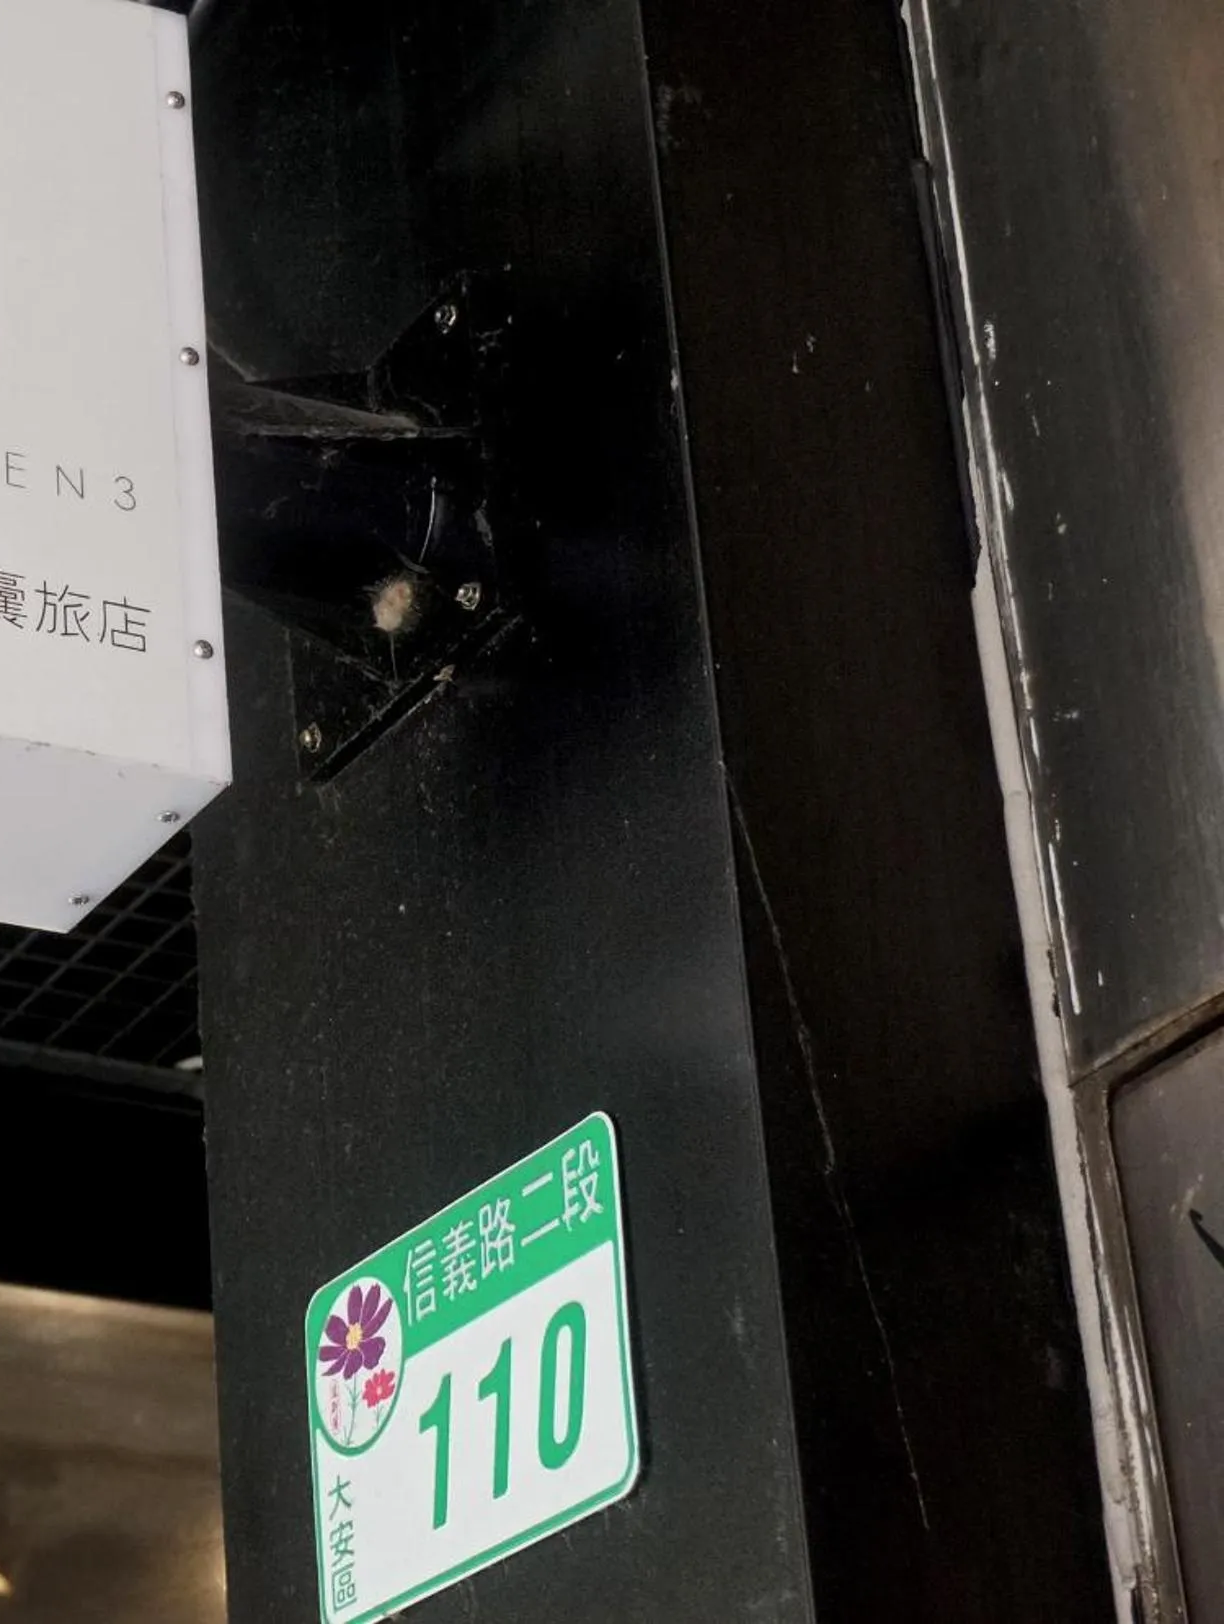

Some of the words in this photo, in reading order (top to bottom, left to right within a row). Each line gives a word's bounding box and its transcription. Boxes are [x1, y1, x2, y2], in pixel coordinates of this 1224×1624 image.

[403, 1139, 605, 1328] 信義路二段
[418, 1300, 587, 1530] 110
[327, 1474, 358, 1614] 大安區
